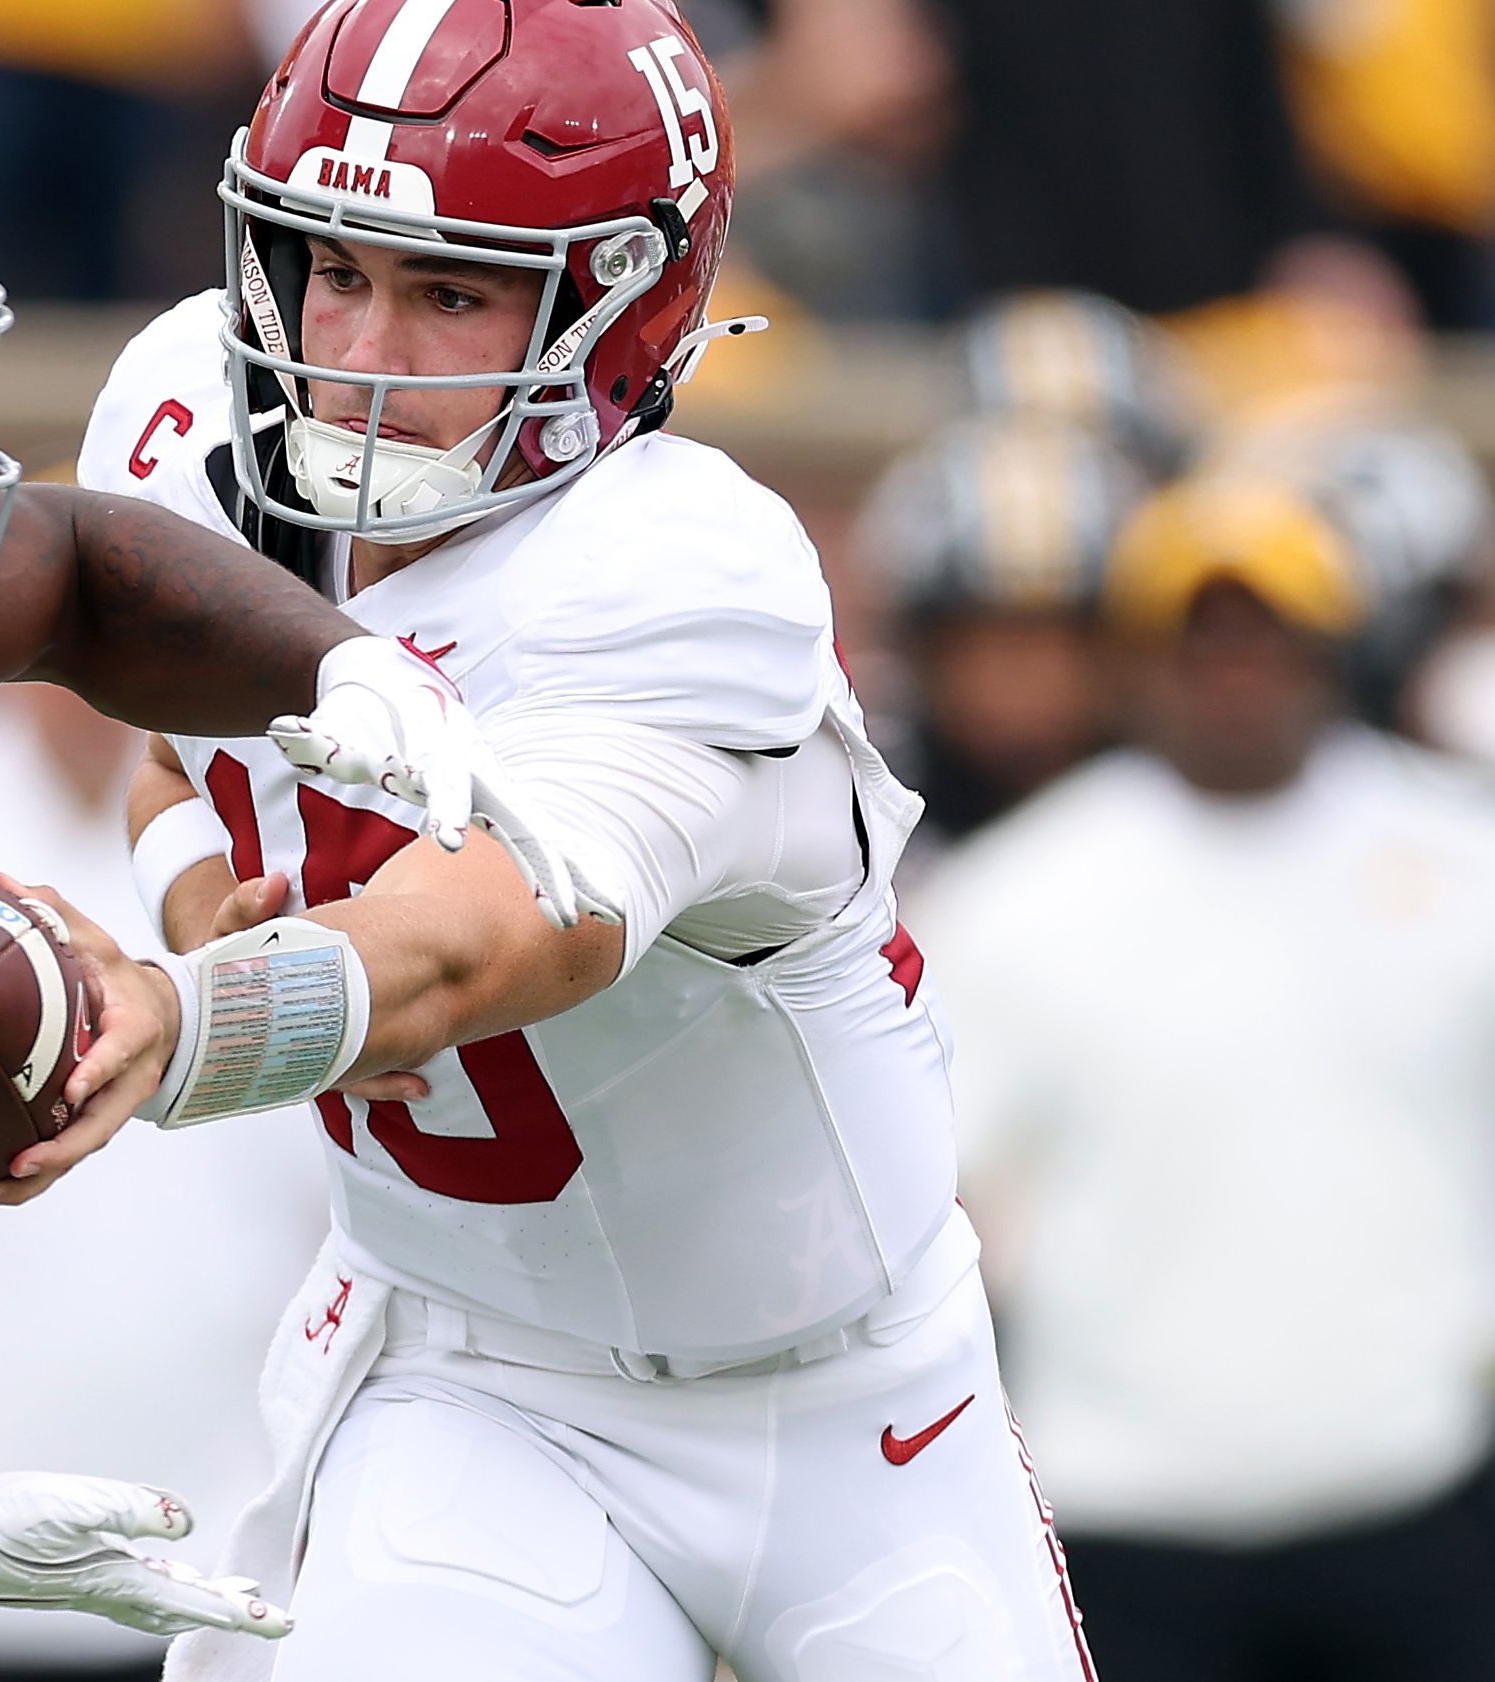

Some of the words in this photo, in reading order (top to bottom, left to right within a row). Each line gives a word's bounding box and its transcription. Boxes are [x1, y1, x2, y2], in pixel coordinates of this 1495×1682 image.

[626, 34, 719, 189] 15
[316, 157, 392, 199] BAMA
[258, 309, 284, 353] TIDE
[128, 398, 194, 481] C
[12, 1062, 34, 1088] A
[305, 1273, 353, 1355] A
